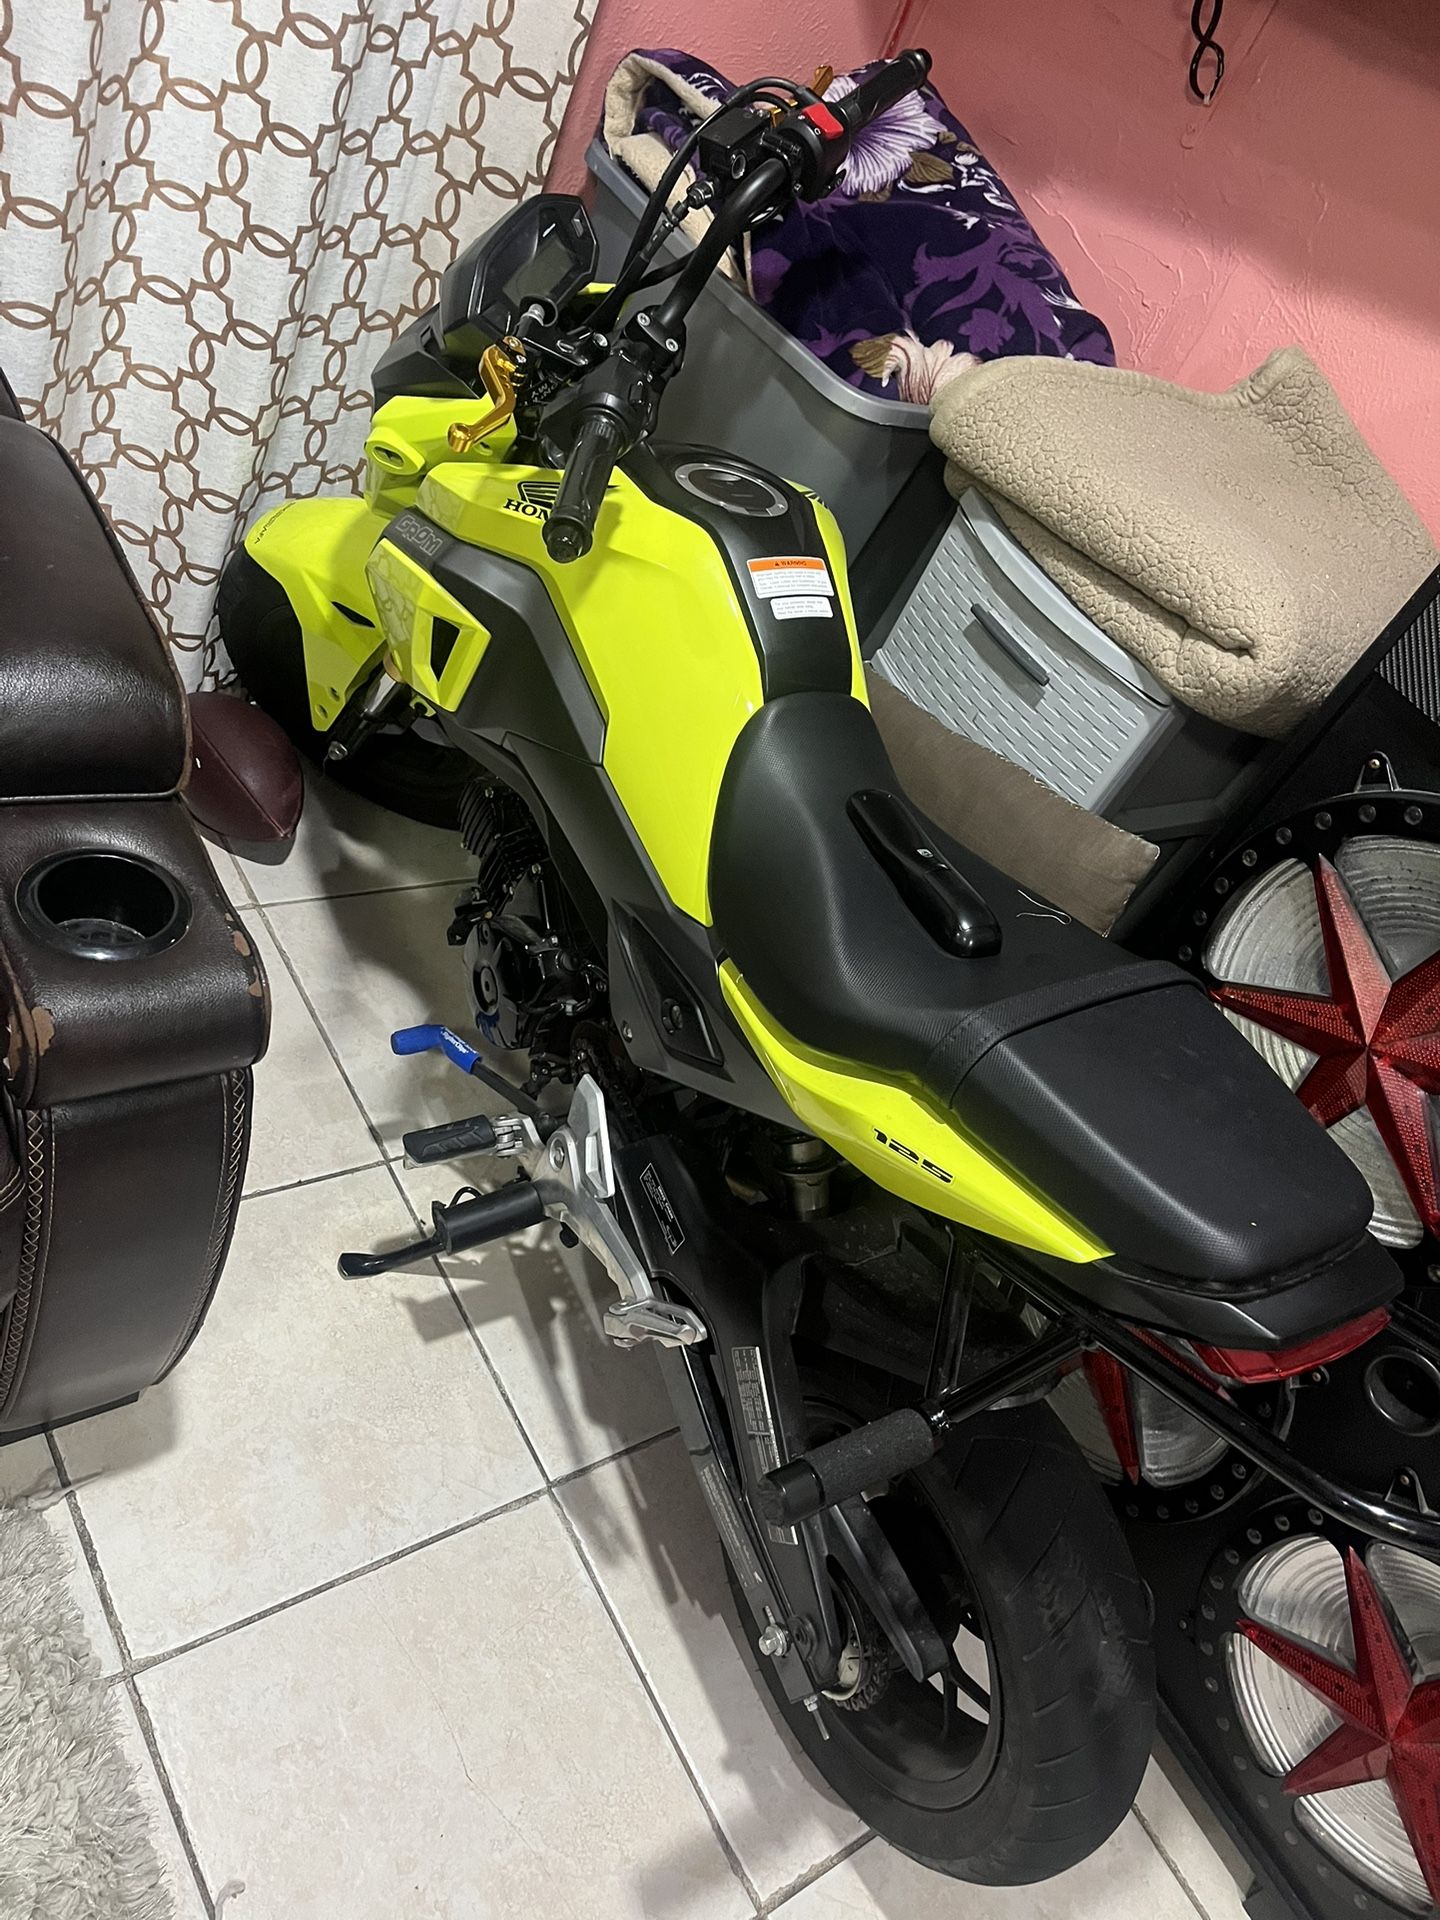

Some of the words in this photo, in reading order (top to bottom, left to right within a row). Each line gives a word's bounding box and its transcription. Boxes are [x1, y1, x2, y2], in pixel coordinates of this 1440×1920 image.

[503, 498, 550, 521] HON
[395, 514, 444, 556] GROM
[874, 1127, 954, 1184] 125
